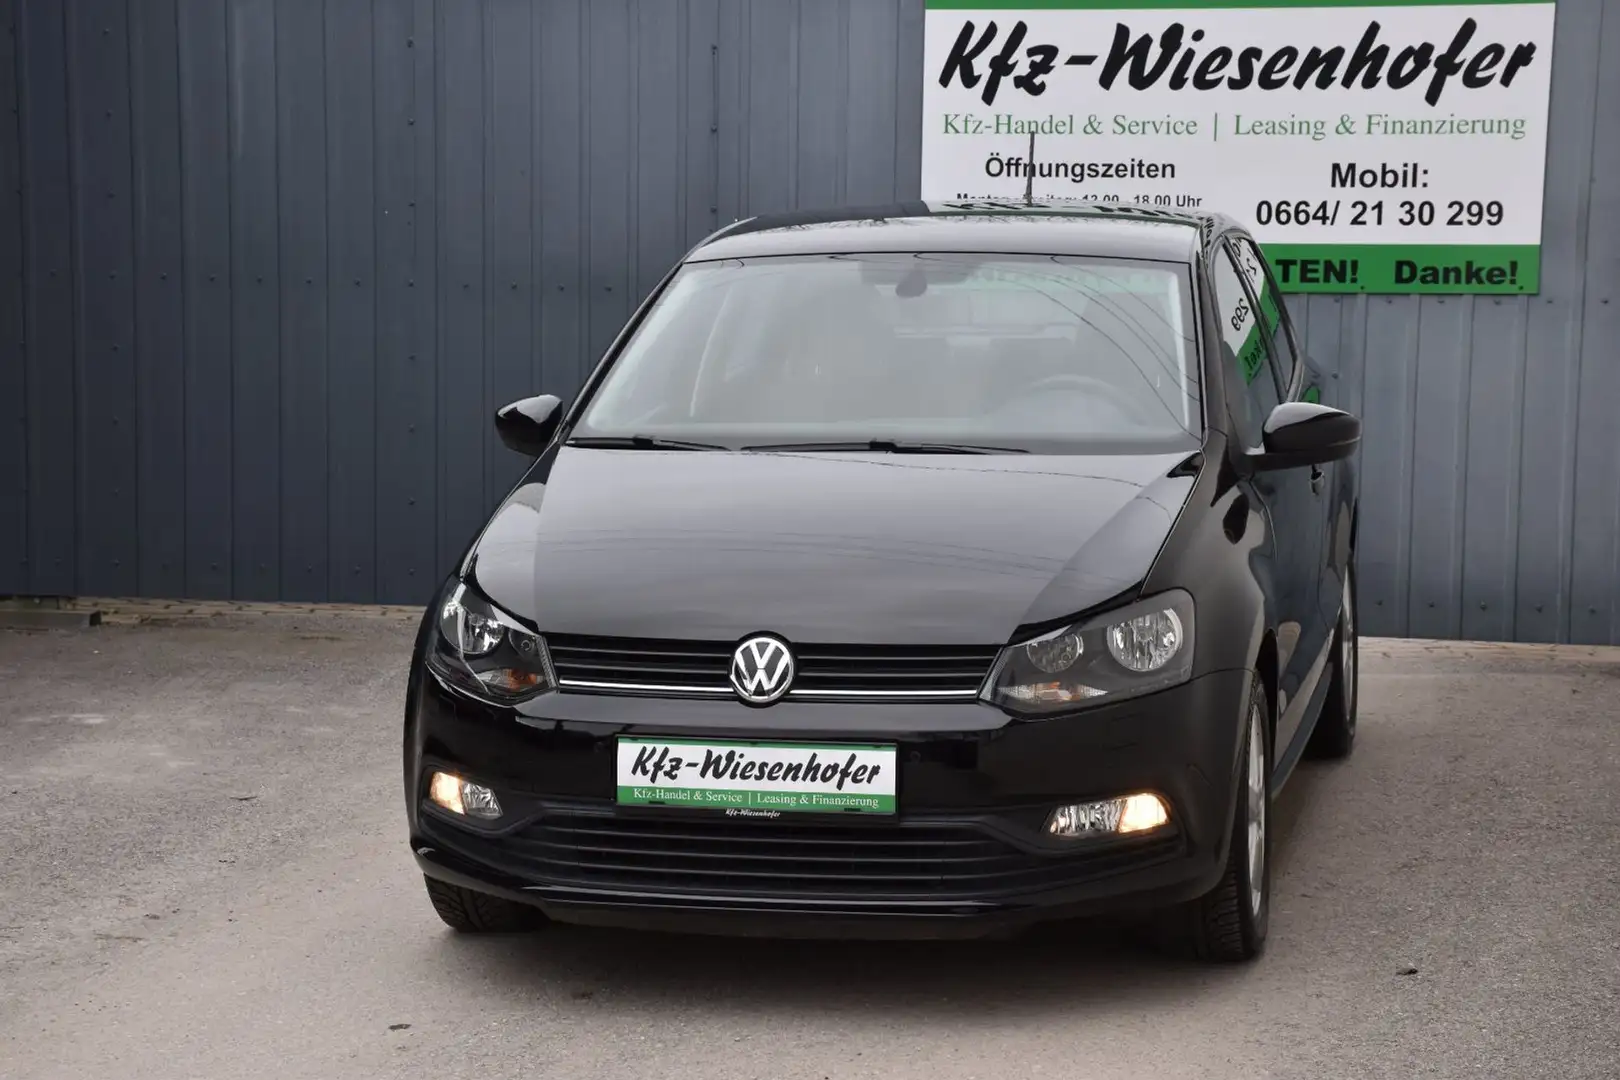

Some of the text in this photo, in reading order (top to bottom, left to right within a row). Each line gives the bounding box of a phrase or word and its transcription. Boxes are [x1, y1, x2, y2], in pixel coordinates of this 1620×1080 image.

[938, 17, 1537, 107] Kfz-Wiesenhofer
[943, 113, 1526, 141] Kfz-Handel & Service Leasing & Finanzierung
[985, 153, 1176, 183] Öffnungszeiten
[1331, 163, 1429, 188] Mobil:
[1176, 194, 1203, 208] Uhr
[1256, 200, 1504, 226] 0664/ 21 30 299
[1394, 260, 1519, 285] Danke!
[631, 746, 881, 791] Kfz-Wiesenhofer
[634, 787, 879, 808] Kfz-Handel & Service Leasing & Finanzierung
